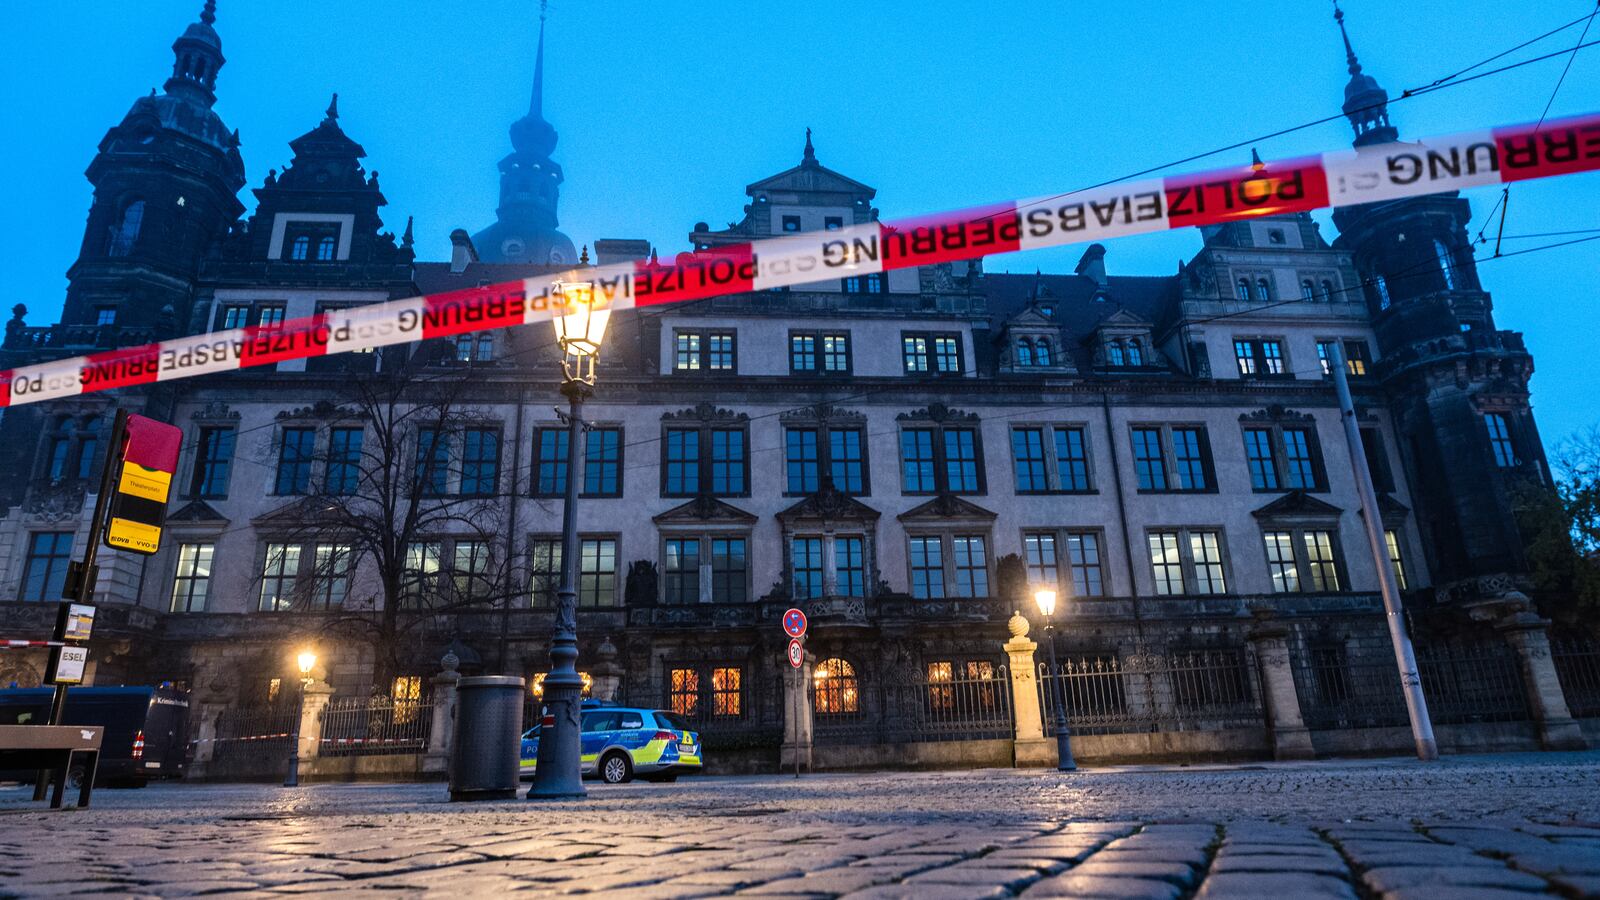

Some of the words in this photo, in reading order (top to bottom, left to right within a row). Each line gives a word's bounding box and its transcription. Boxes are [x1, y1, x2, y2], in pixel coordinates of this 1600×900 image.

[822, 169, 1304, 268] POLIZEIABSPERRUNG
[79, 318, 350, 385] POLIZEIABSPERRUNG
[63, 652, 83, 662] ESEL
[792, 646, 799, 659] 30
